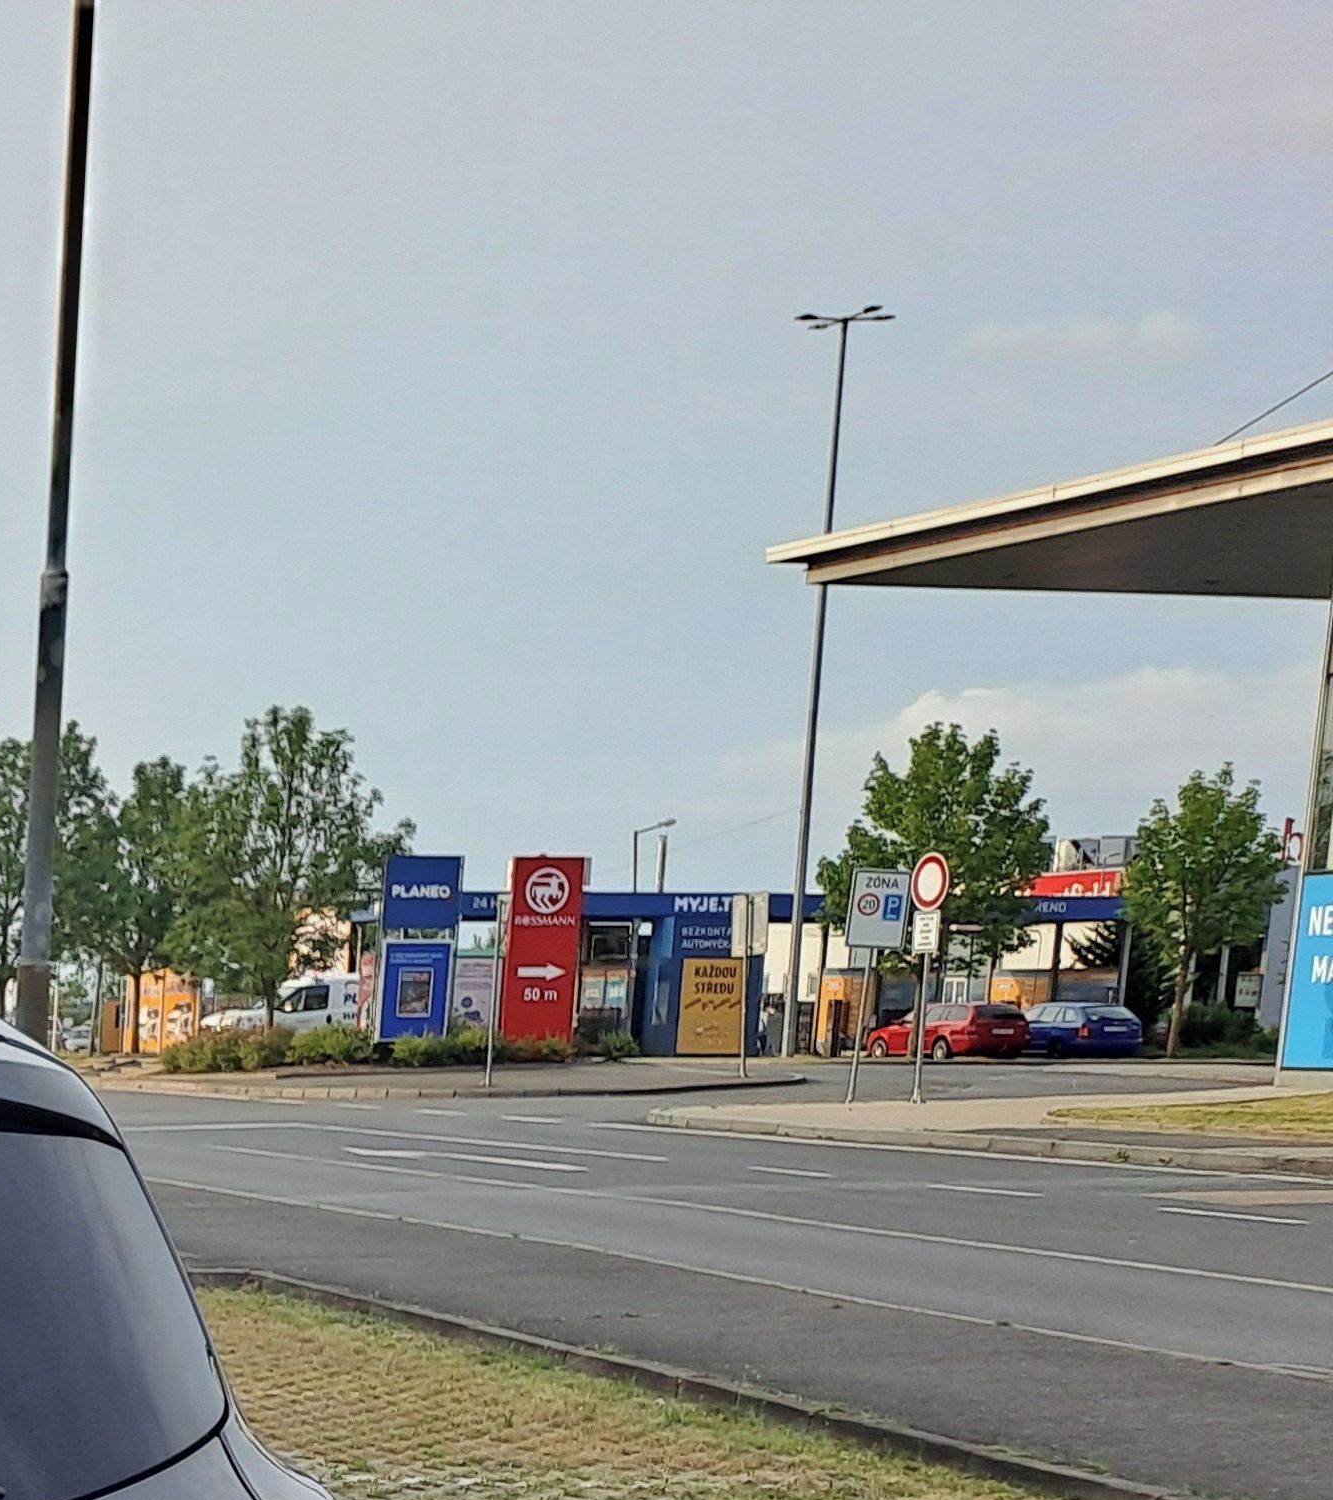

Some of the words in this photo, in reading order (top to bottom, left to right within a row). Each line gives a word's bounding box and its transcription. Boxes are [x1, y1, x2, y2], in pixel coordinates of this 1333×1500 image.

[391, 884, 452, 899] PLANEO
[862, 899, 876, 910] 20
[887, 896, 900, 914] P
[514, 915, 576, 927] ROSSMANN
[681, 938, 732, 949] AUTOMYČK
[544, 989, 558, 1001] m
